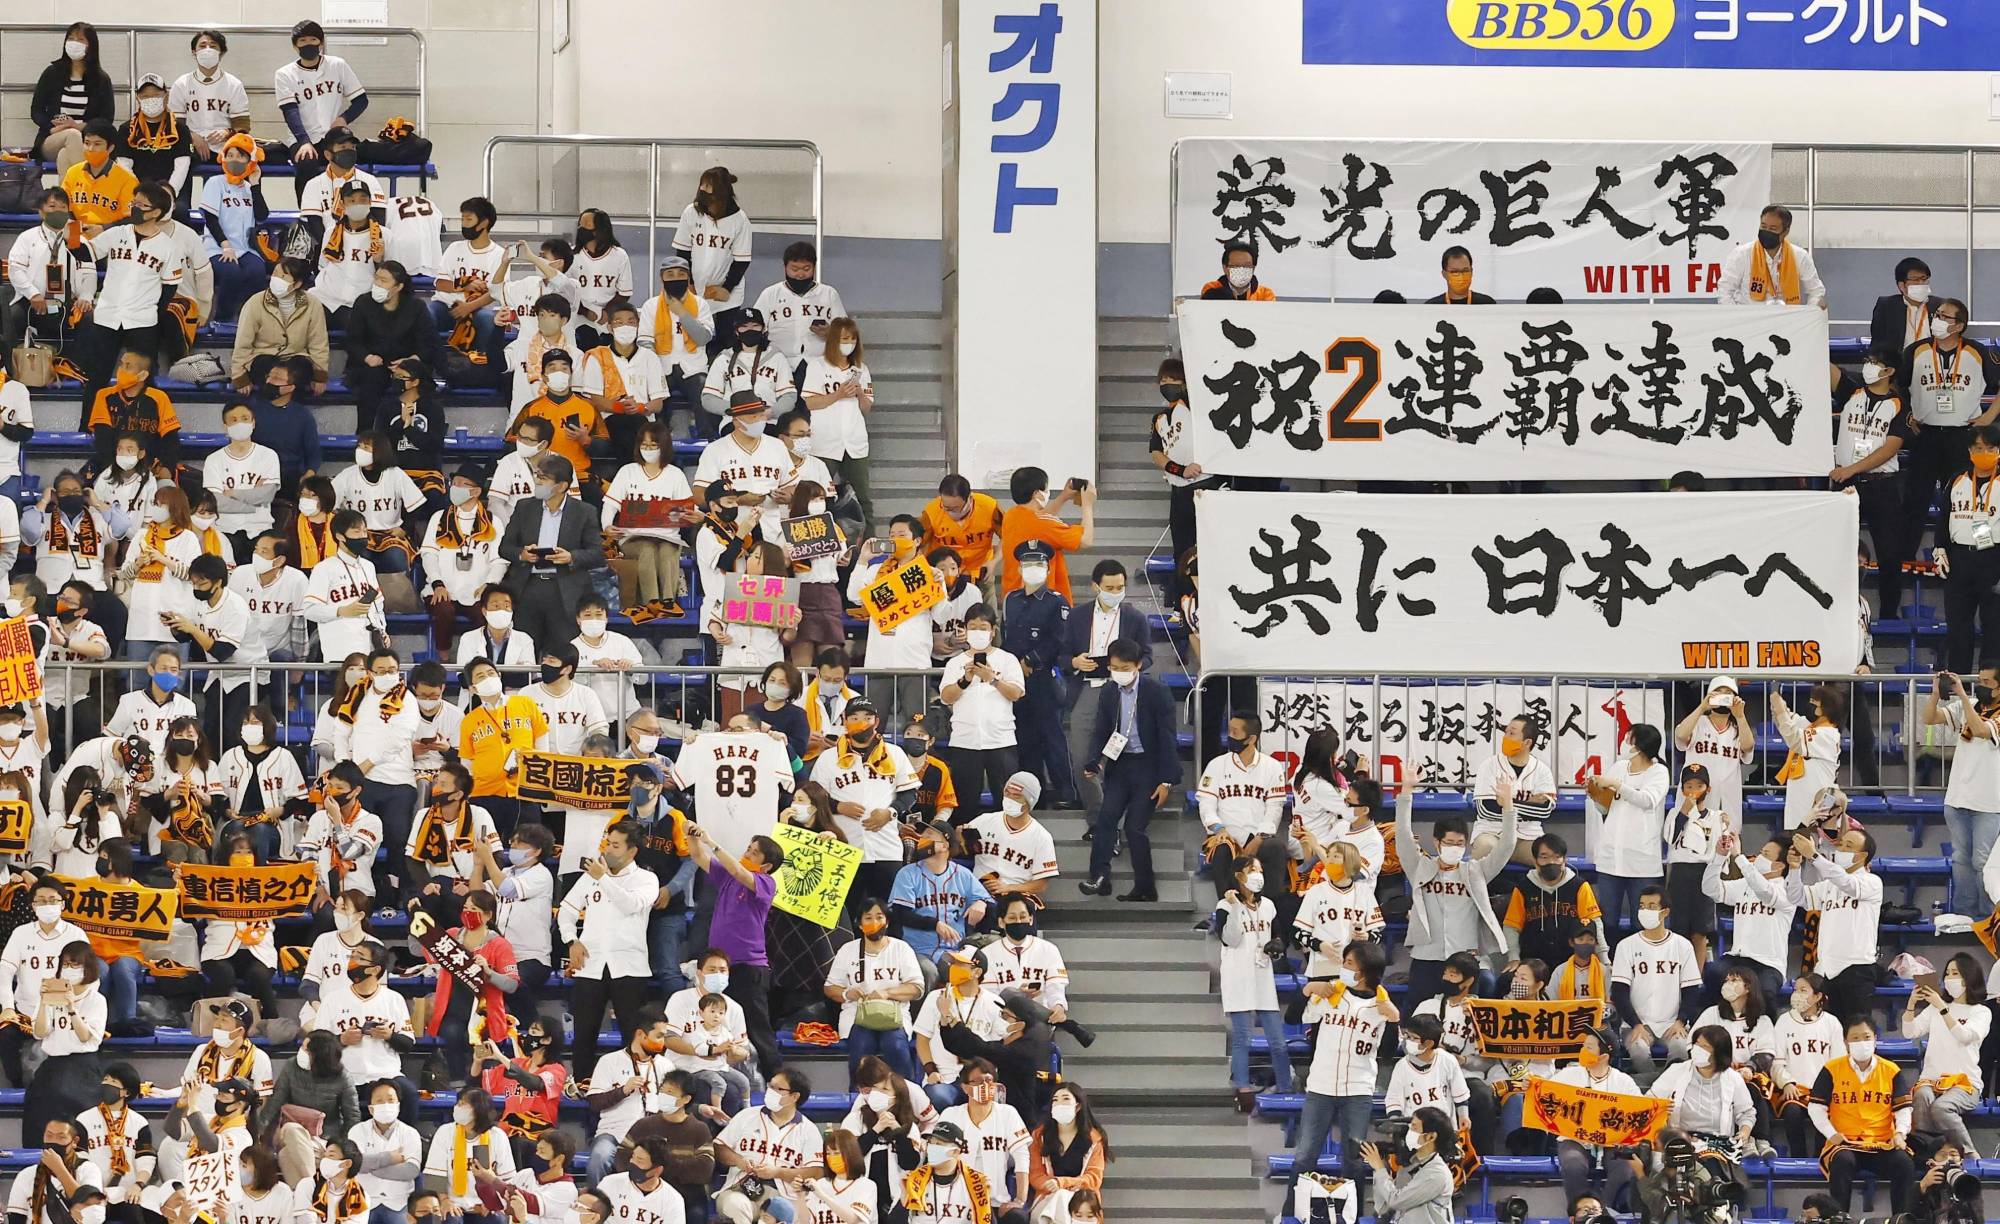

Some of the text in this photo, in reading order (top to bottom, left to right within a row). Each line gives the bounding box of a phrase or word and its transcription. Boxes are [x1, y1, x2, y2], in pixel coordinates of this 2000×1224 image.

[1468, 0, 1653, 40] BB536
[988, 3, 1063, 234] オクト
[72, 191, 118, 212] IANTS
[223, 197, 253, 207] TOK
[394, 195, 431, 220] 25
[1212, 153, 1737, 261] 栄光の巨人軍
[578, 275, 616, 288] OKY
[1583, 262, 1722, 294] WITH FA
[1750, 283, 1763, 294] 83
[1202, 319, 1803, 451] 祝2連覇達成
[720, 464, 781, 482] GIANTS
[330, 581, 368, 603] GIAN
[1681, 640, 1822, 669] WITH FANS
[713, 744, 760, 763] HARA
[715, 764, 756, 798] 83
[914, 894, 967, 911] GIANTS
[1317, 907, 1365, 926] TOKY
[1632, 960, 1681, 976] OKY
[1472, 1006, 1599, 1041] 岡本和真
[1793, 1041, 1830, 1056] OKY
[1832, 1091, 1893, 1107] GIANTS
[740, 1137, 804, 1168] GIANTS
